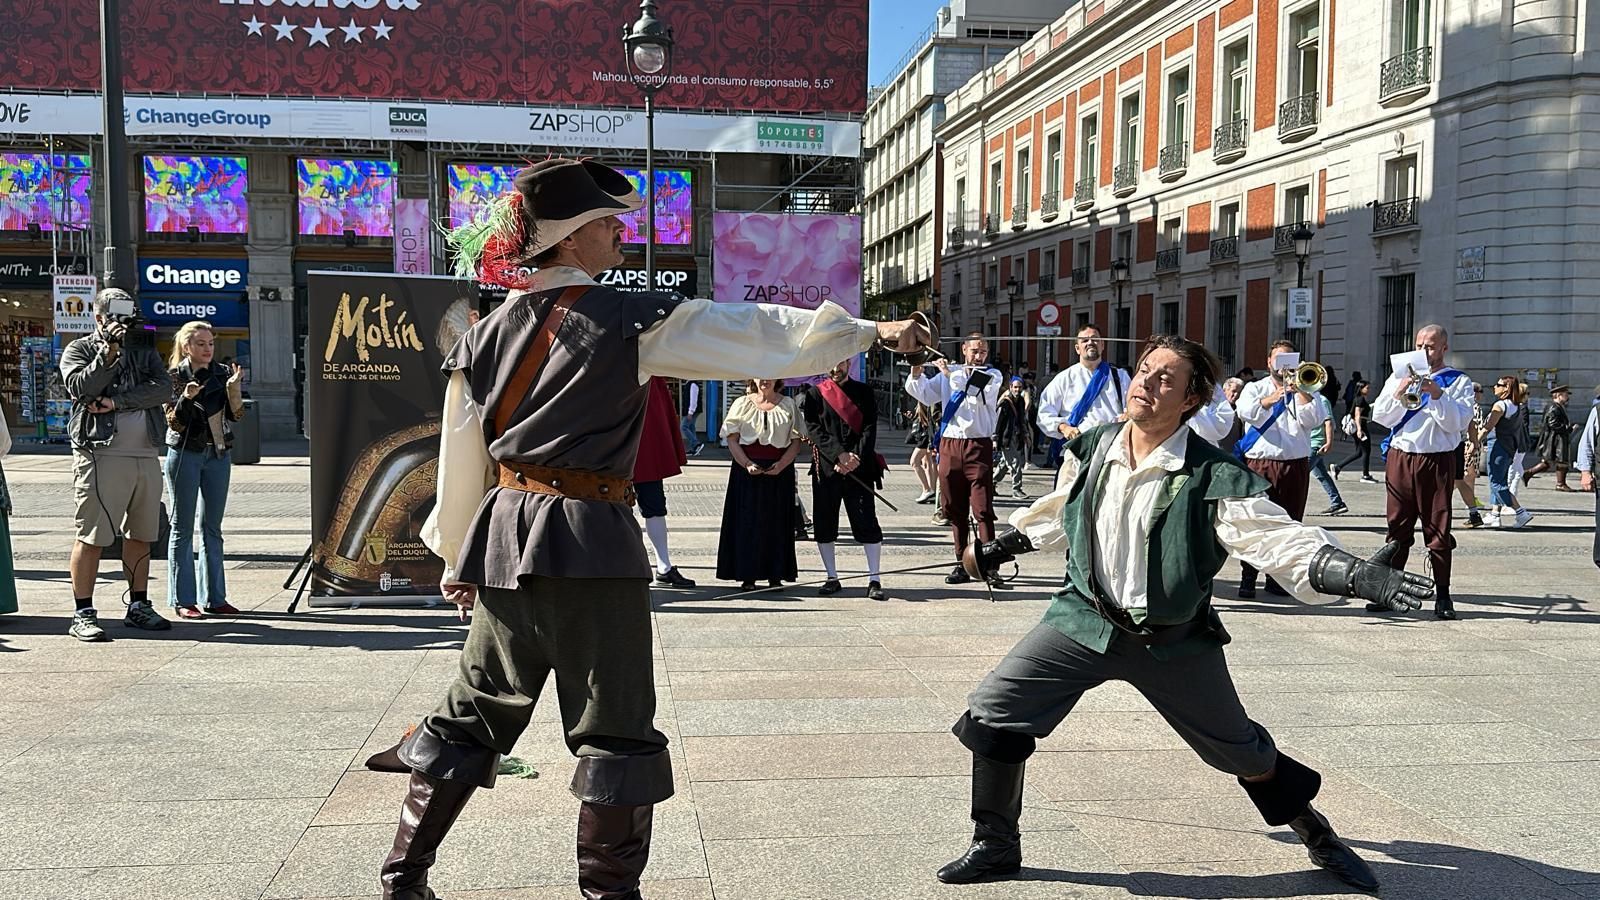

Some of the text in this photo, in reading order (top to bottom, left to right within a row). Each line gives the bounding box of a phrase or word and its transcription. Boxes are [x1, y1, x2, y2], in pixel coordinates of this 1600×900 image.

[592, 71, 627, 82] Mahou
[691, 75, 700, 84] el
[702, 77, 747, 86] consumo
[750, 78, 812, 89] responsable,
[136, 108, 271, 128] ChangeGroup
[390, 112, 426, 122] EJUCA
[760, 126, 822, 138] SOPORTES
[402, 228, 418, 274] SHOP
[0, 264, 32, 276] WITH
[146, 264, 241, 289] Change
[268, 291, 275, 300] 6
[744, 285, 832, 302] ZAPSHOP
[153, 302, 217, 318] Change
[324, 292, 424, 362] Motín
[323, 364, 400, 373] DE ARGANDA
